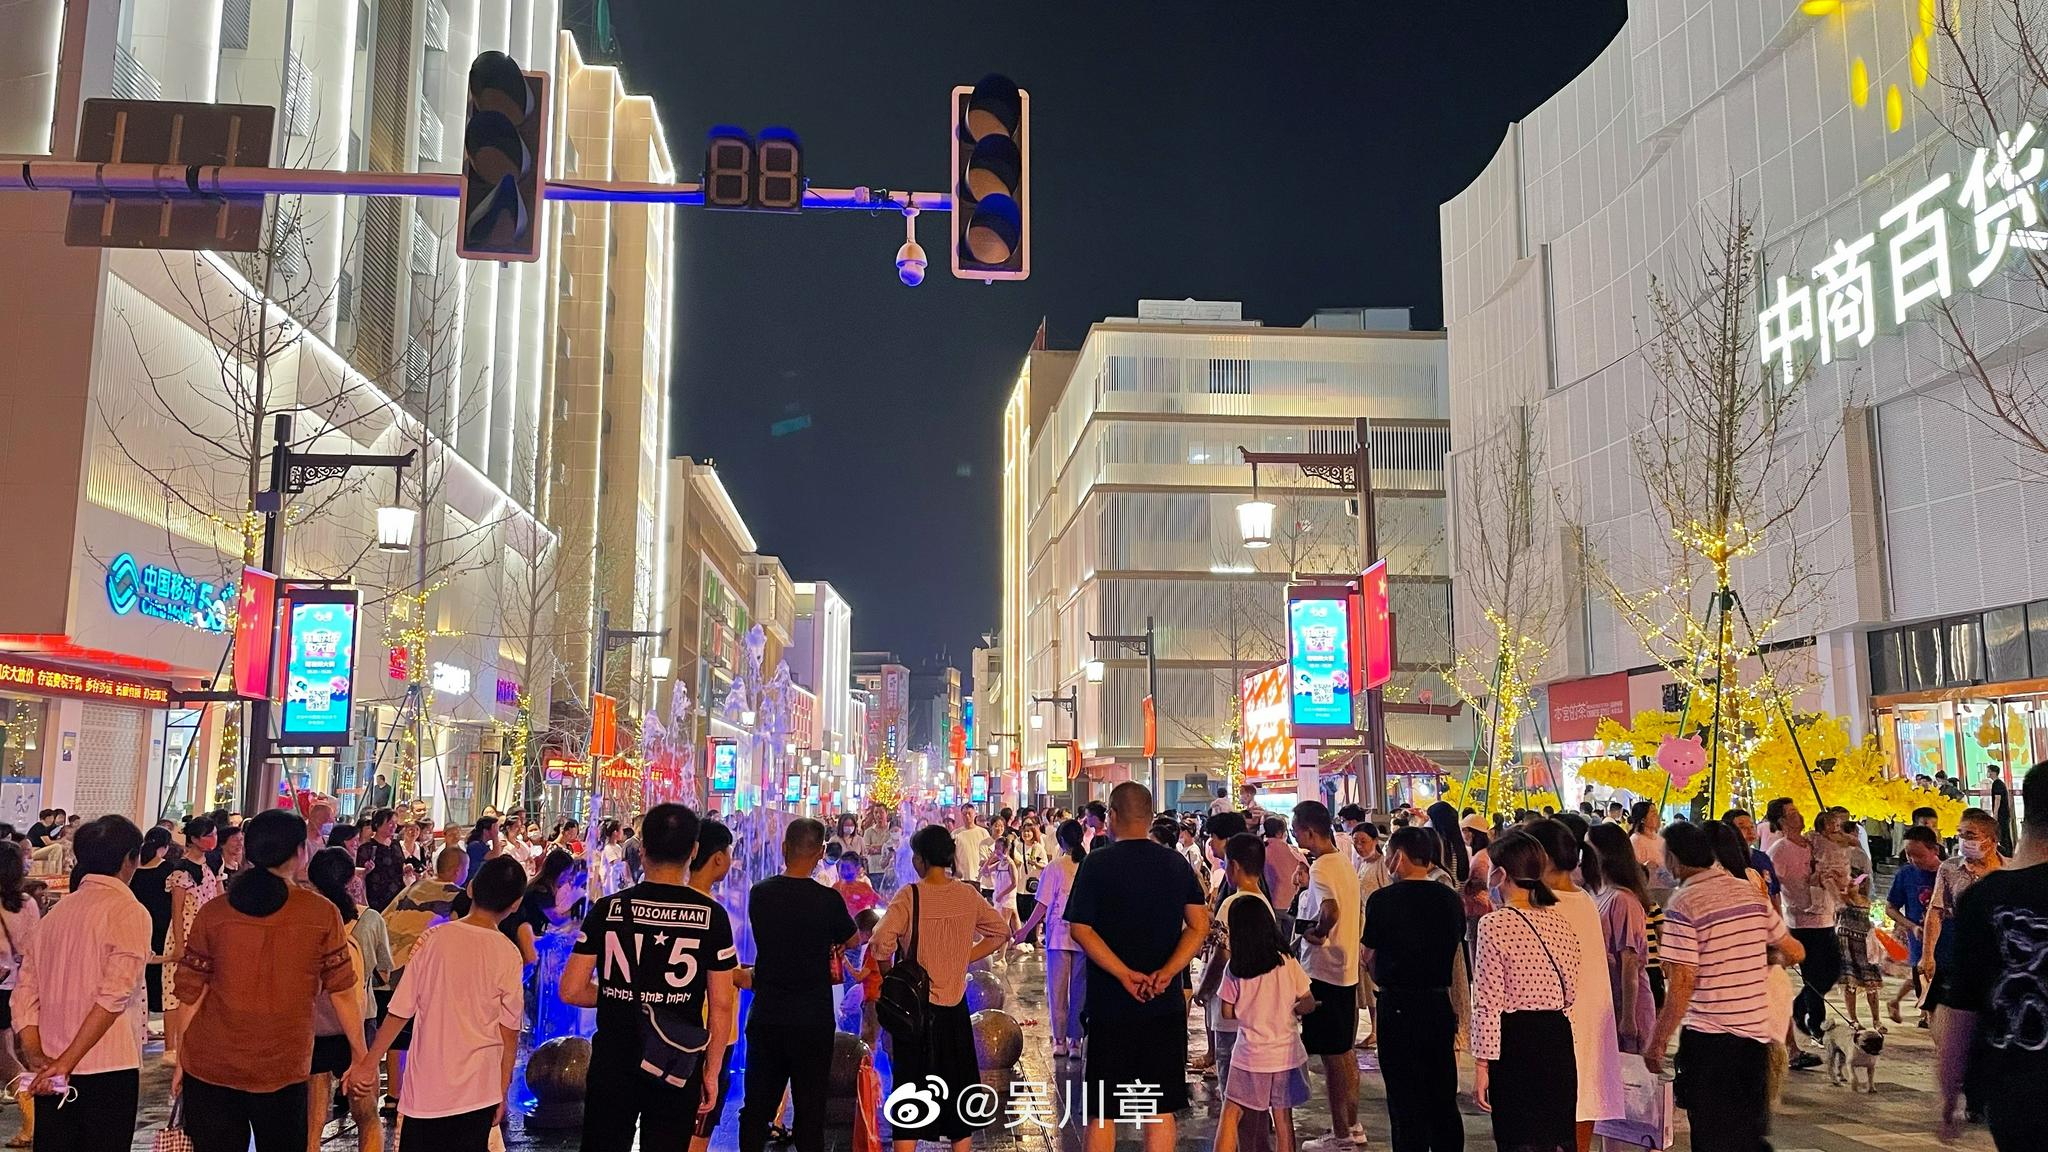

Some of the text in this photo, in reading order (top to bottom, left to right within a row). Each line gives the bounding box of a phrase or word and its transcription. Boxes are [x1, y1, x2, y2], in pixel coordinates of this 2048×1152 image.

[1758, 121, 2047, 385] 中商百货
[143, 565, 197, 605] 中国移动
[614, 904, 705, 923] HNDSOME MAN
[664, 937, 701, 988] 5
